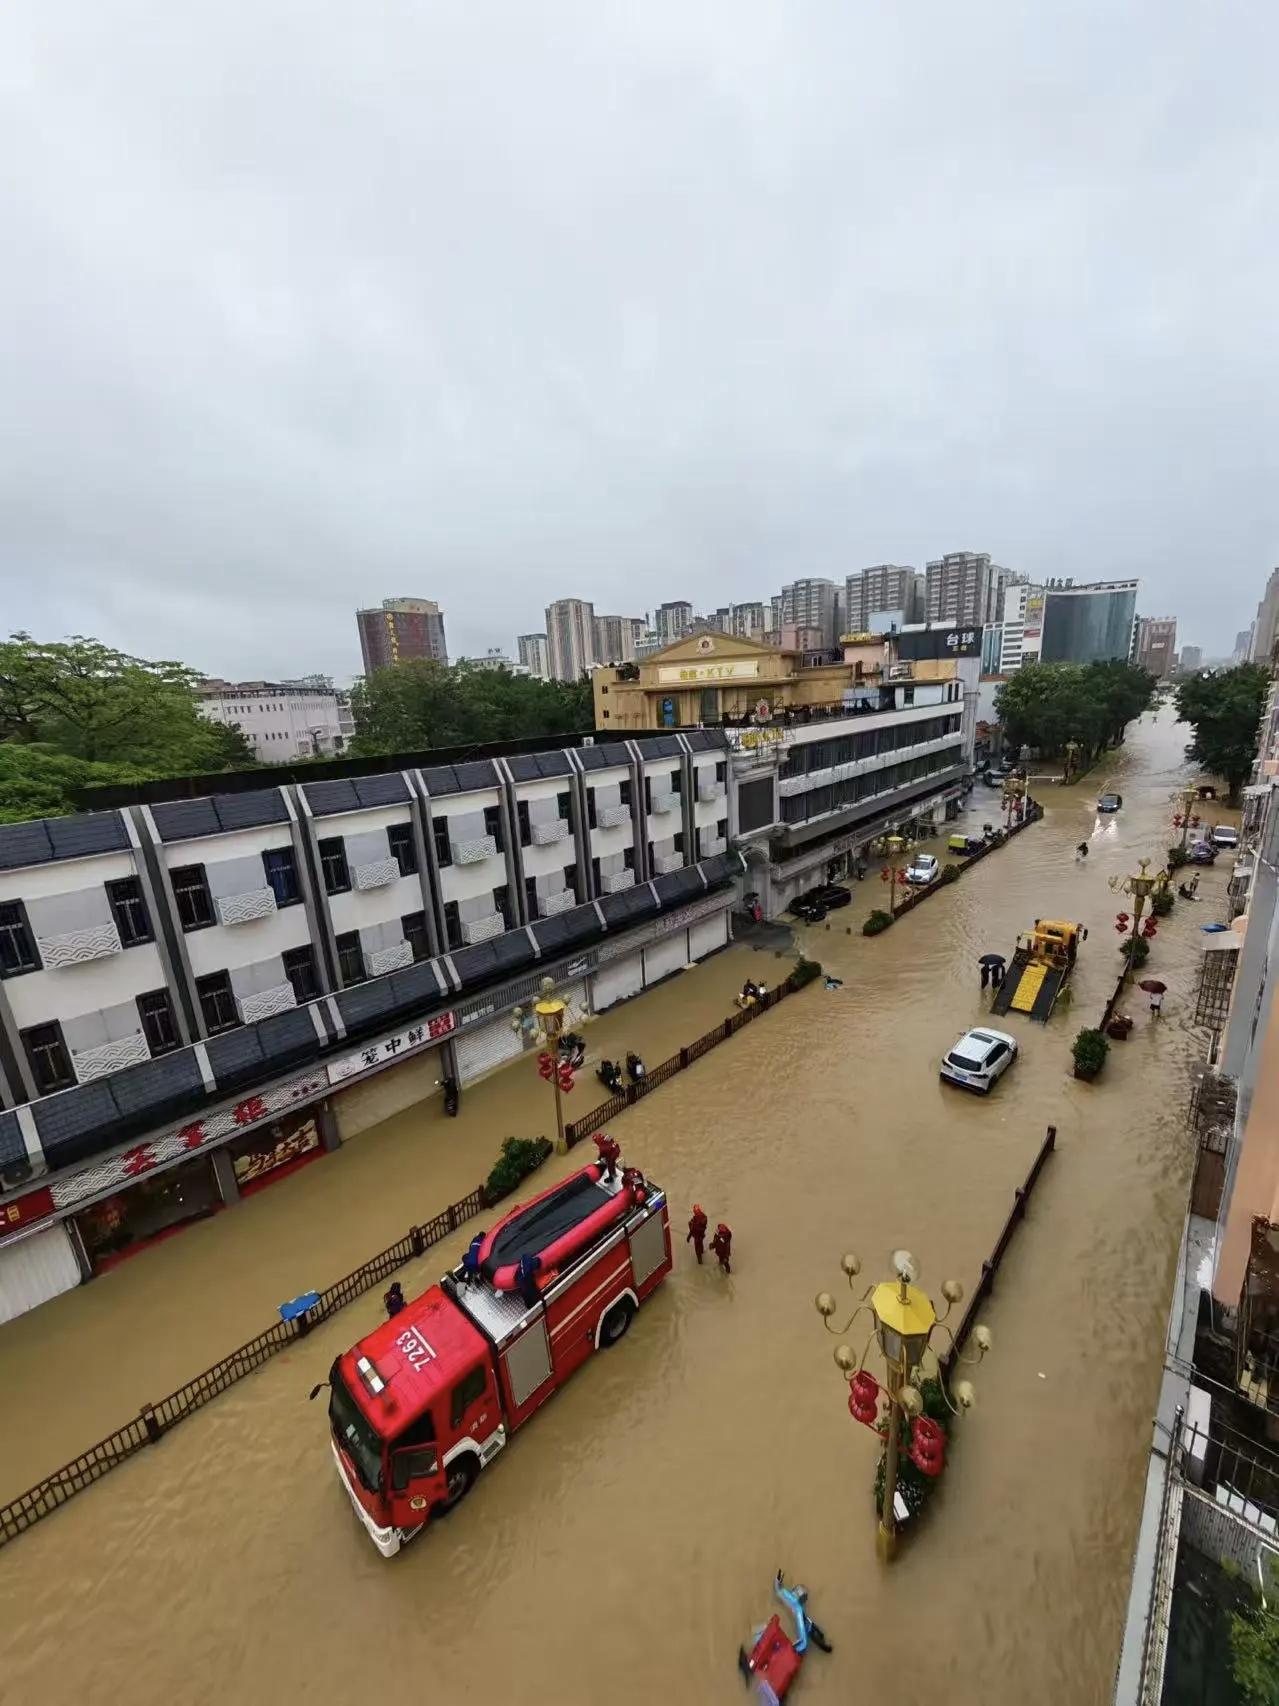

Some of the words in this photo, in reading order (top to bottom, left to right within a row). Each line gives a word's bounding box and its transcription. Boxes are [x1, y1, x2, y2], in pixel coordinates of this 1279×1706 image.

[946, 632, 975, 646] 台球
[361, 1027, 425, 1067] 笼中鲜
[396, 1329, 431, 1372] 7263
